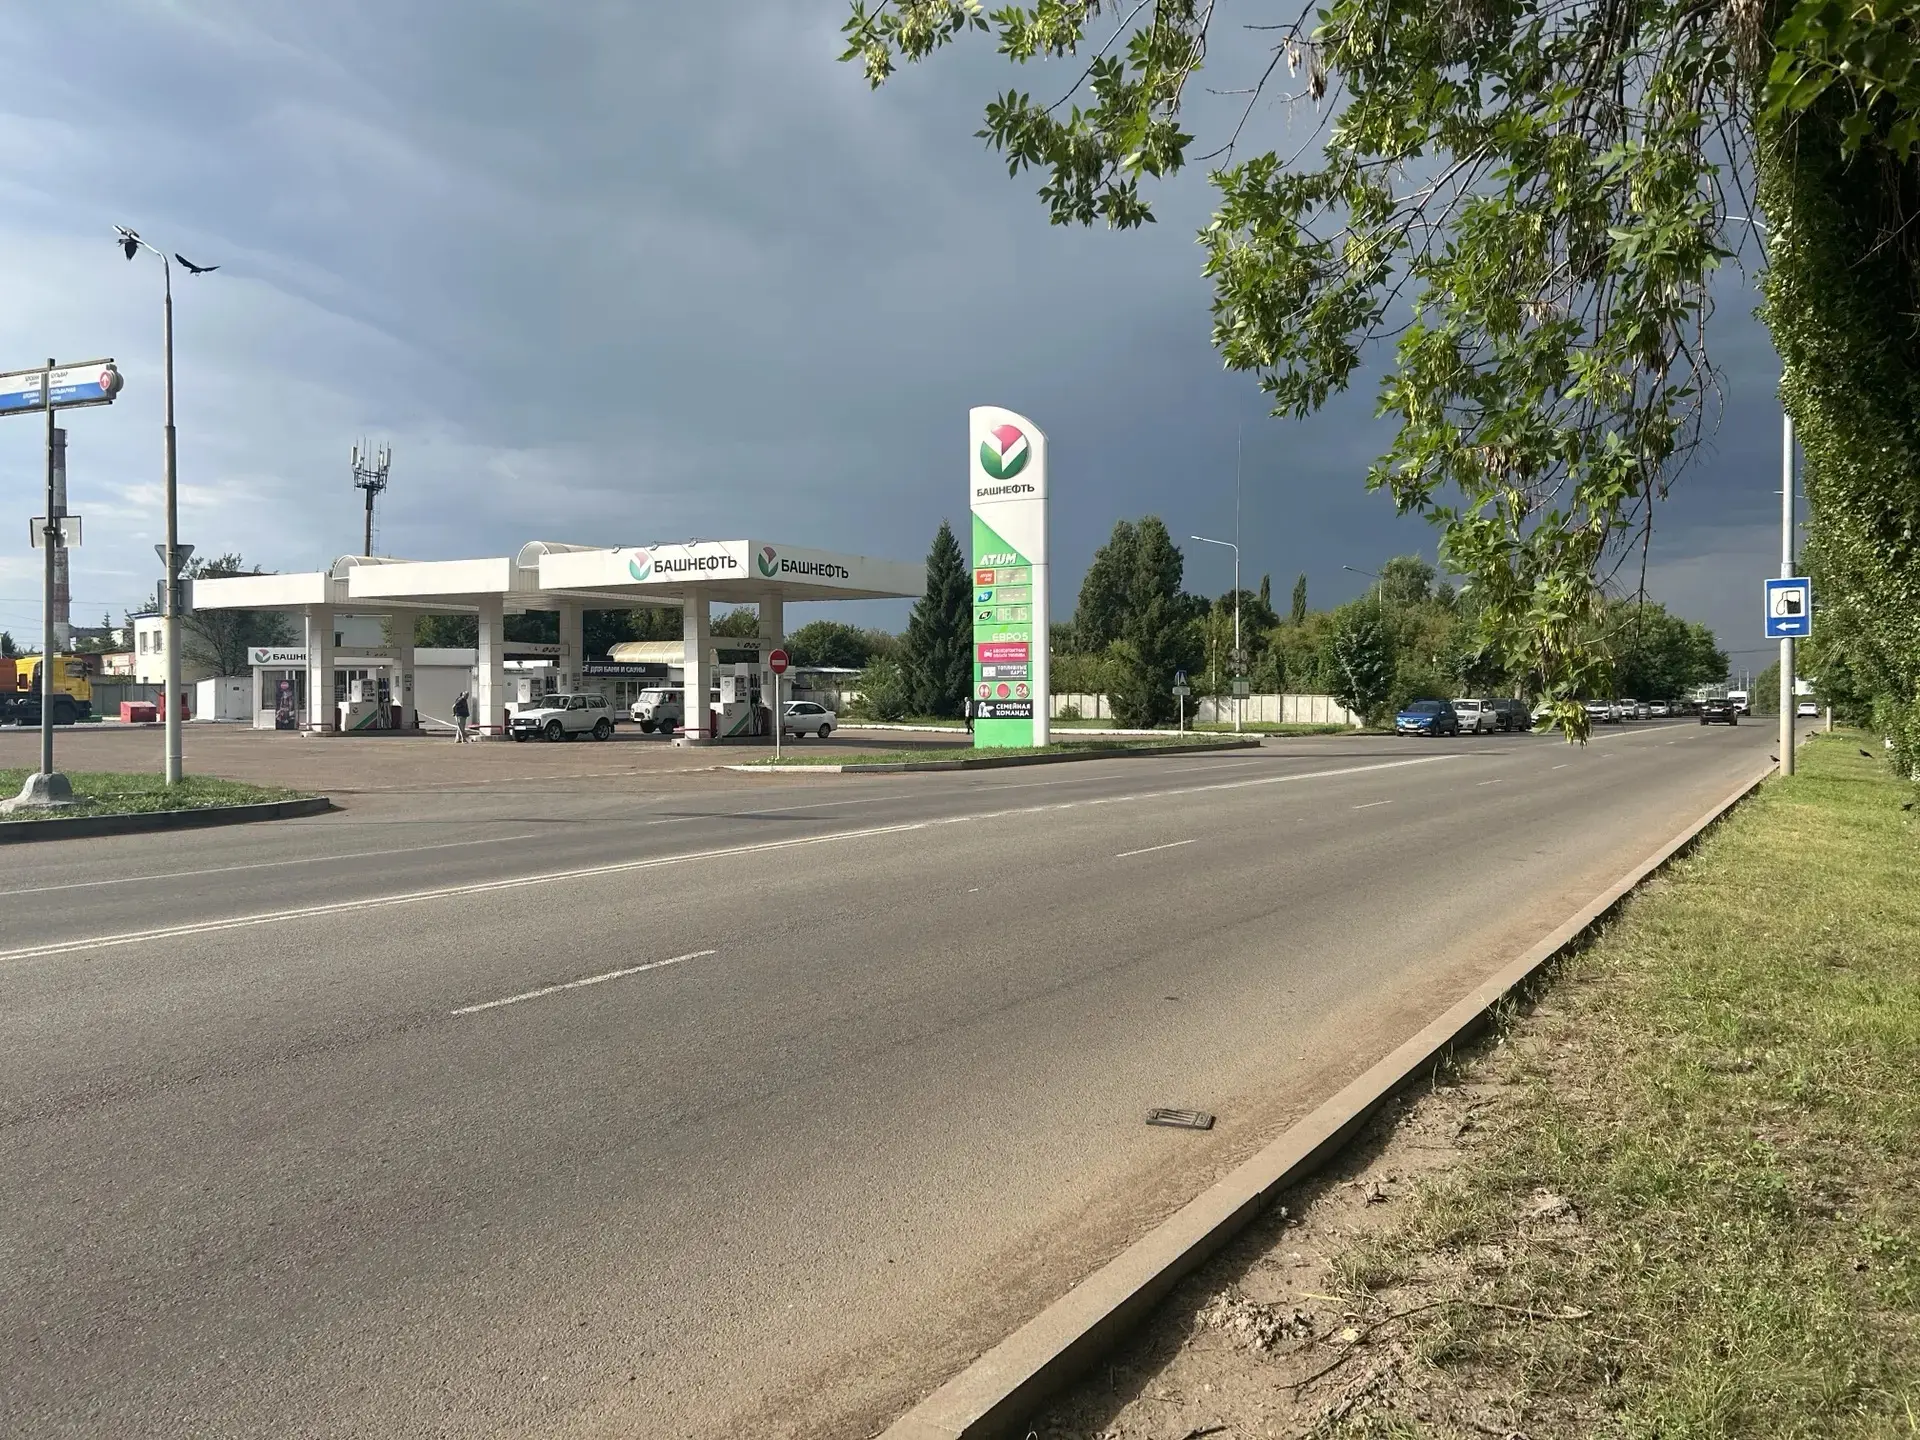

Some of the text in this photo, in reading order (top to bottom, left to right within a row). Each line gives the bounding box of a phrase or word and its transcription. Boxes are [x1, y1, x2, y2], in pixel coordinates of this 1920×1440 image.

[976, 484, 1035, 497] БАШНЕФТЬ
[653, 555, 738, 573] БАШНЕФТЬ
[980, 553, 1017, 566] ATUM
[781, 558, 849, 579] БАШНЕФТЬ
[590, 666, 603, 674] ДЛЯ
[1016, 685, 1028, 695] 24
[996, 702, 1030, 710] СЕМЕЙНАЯ
[996, 709, 1029, 717] КОМАНДА
